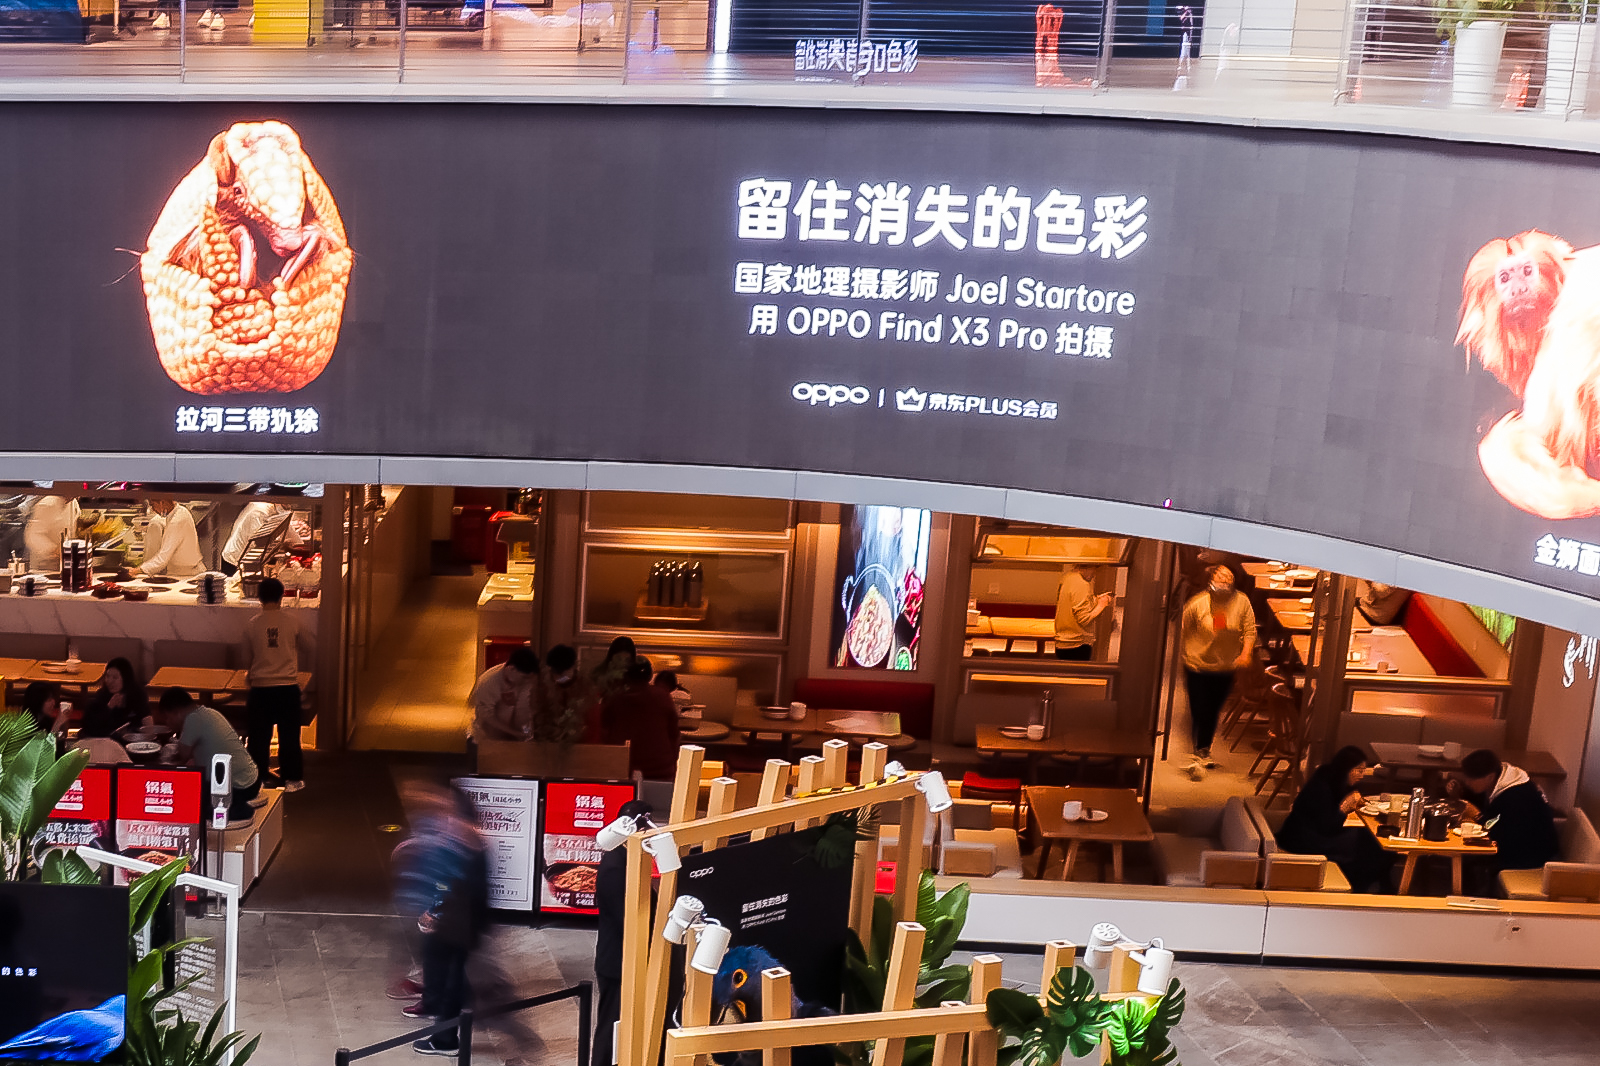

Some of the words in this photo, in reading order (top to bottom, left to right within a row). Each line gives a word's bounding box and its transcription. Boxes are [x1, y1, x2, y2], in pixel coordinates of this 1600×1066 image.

[737, 177, 1149, 260] 留住消失的色彩
[734, 262, 940, 302] 国家地理摄影师
[946, 274, 1008, 305] Joel
[1015, 278, 1137, 316] Startore
[749, 305, 778, 336] 用
[787, 308, 871, 339] OPPO
[879, 312, 943, 343] Find
[950, 316, 990, 347] X3
[999, 319, 1049, 351] Pro
[1055, 323, 1114, 359] 拍摄
[175, 406, 320, 433] 拉河三带犰狳
[928, 393, 1059, 420] 京东PLUS会员
[1534, 533, 1600, 577] 金狮面
